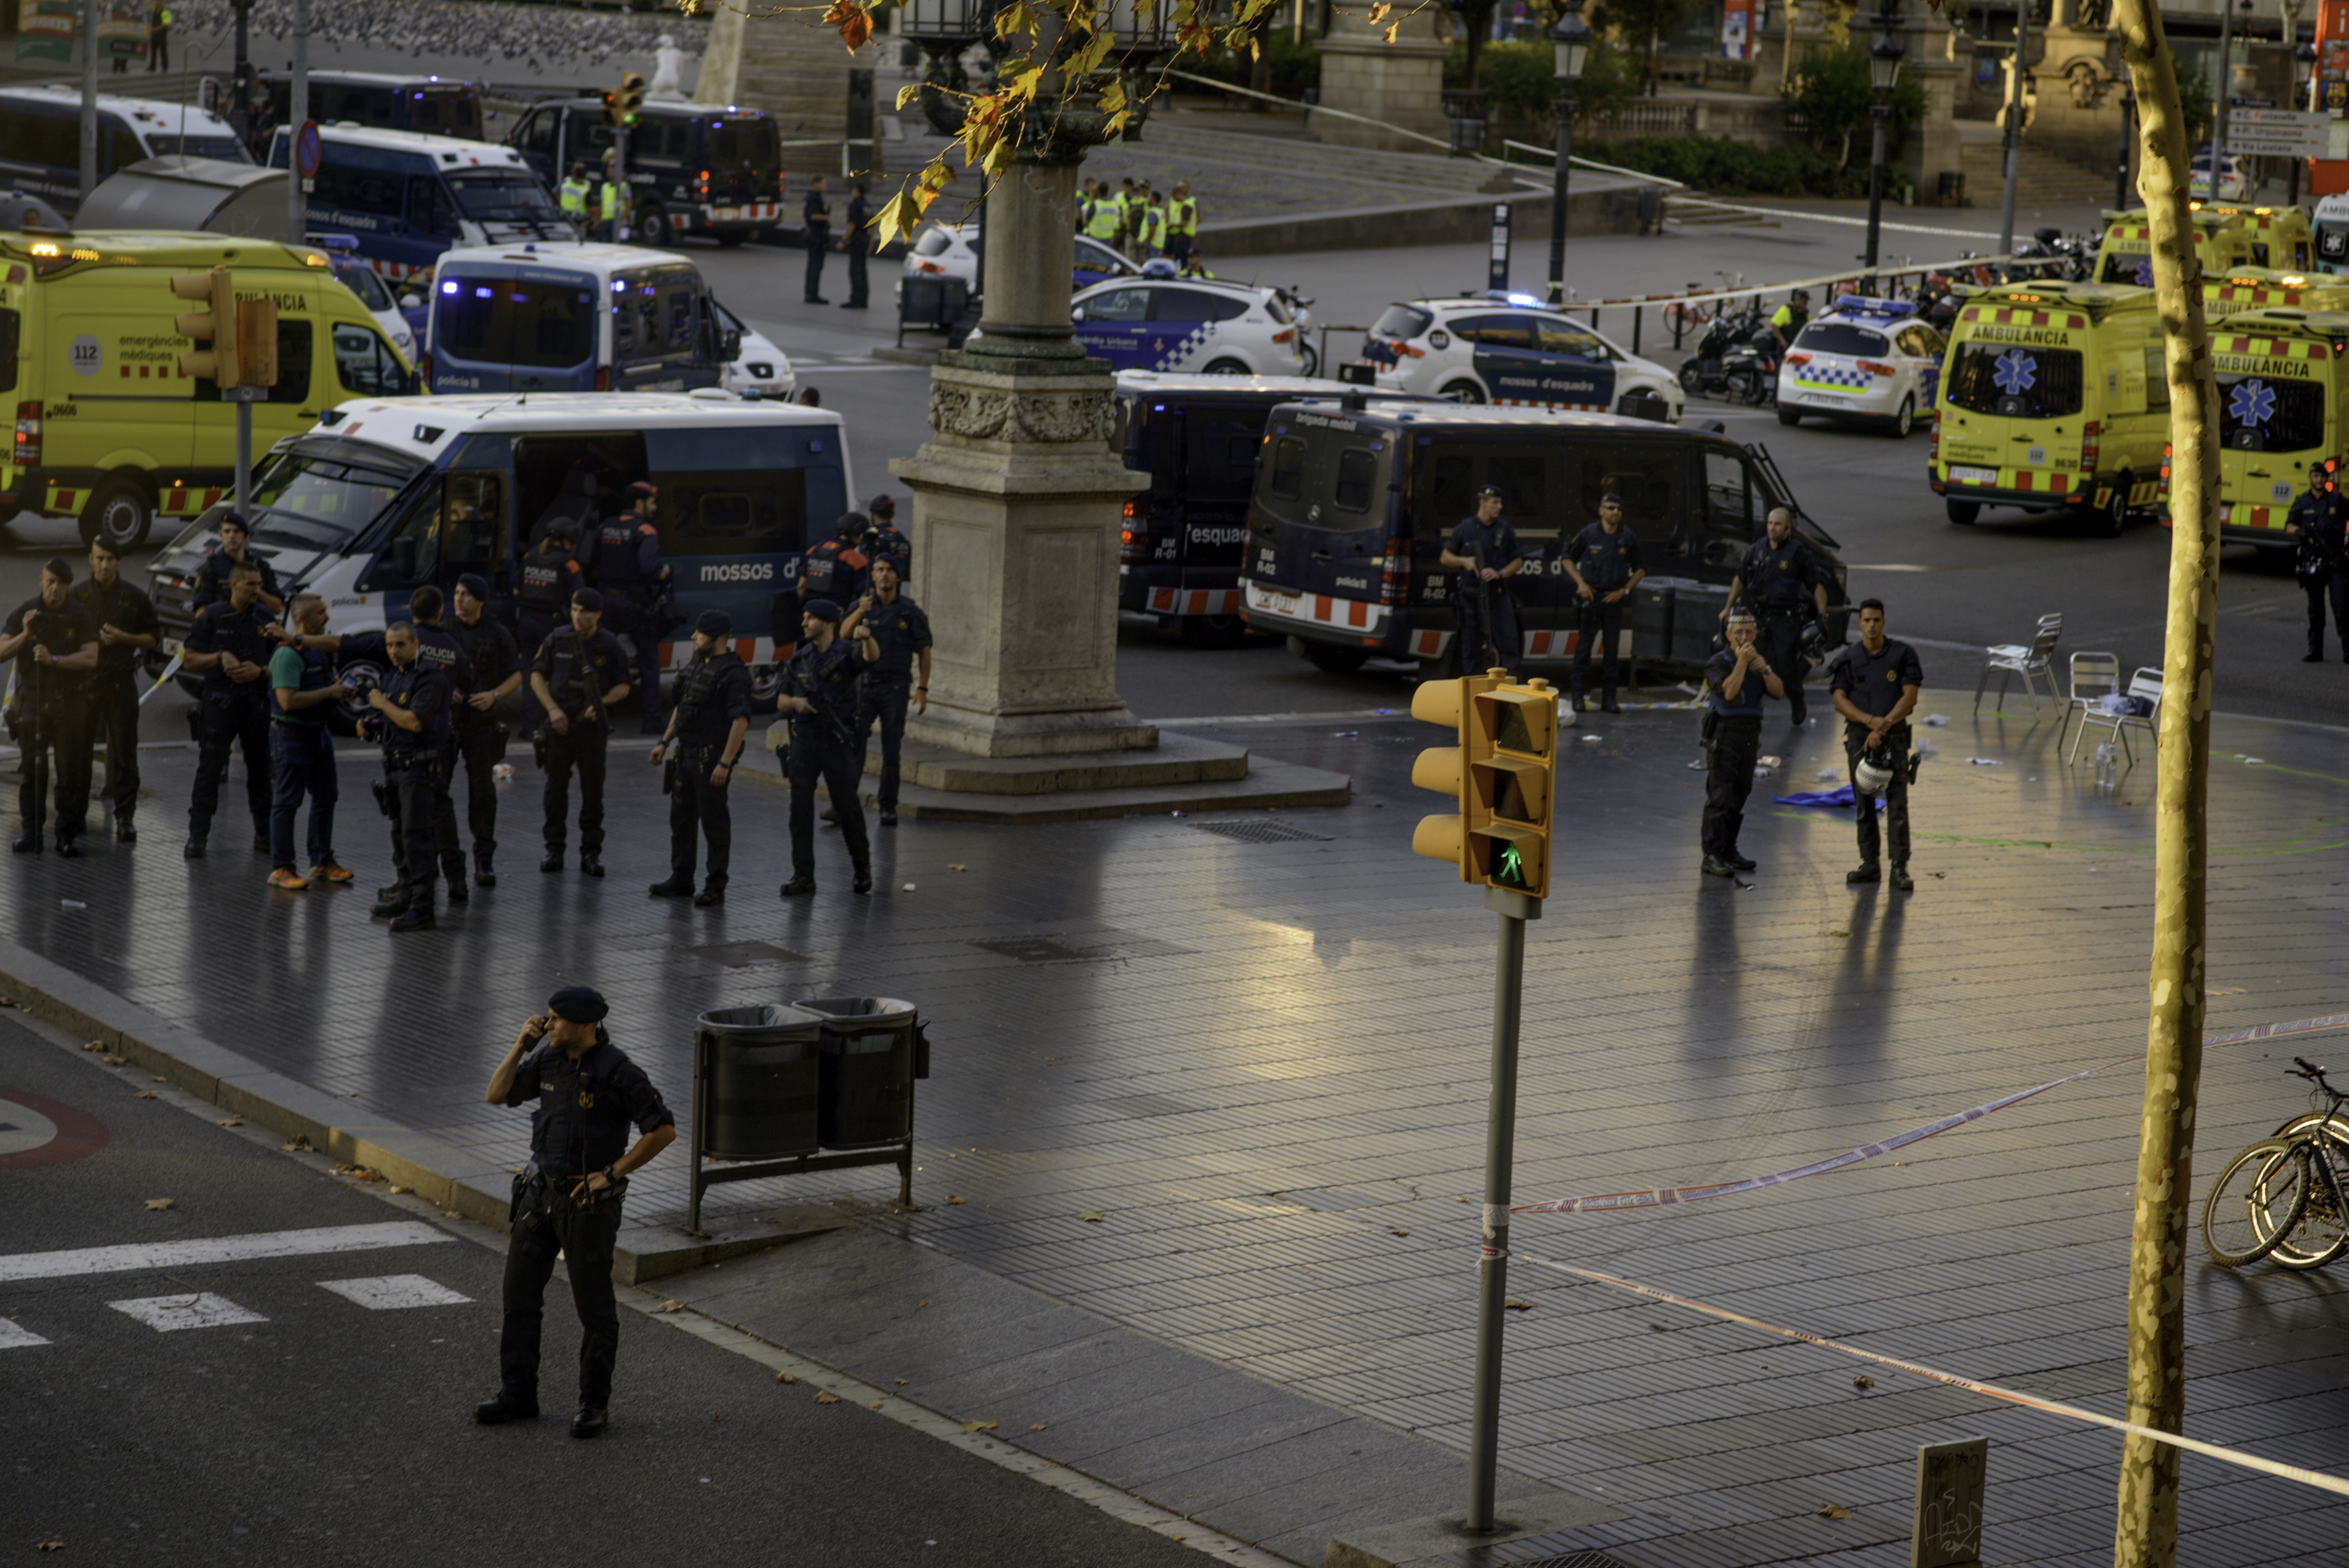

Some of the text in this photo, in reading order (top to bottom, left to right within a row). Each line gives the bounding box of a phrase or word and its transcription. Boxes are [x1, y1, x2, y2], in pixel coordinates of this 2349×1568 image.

[120, 336, 189, 349] emergències
[75, 345, 97, 359] 112
[120, 350, 173, 363] mèdiques
[1499, 376, 1595, 392] mossos d'esquadra
[1296, 412, 1328, 428] brigada
[2030, 450, 2044, 459] 112
[2275, 486, 2289, 496] 112
[1161, 537, 1176, 548] BM
[1155, 547, 1176, 560] R-01
[1260, 547, 1275, 562] BM
[524, 566, 557, 578] POLICIA
[700, 564, 774, 582] mossos
[1256, 560, 1276, 576] R-02
[1427, 575, 1444, 587] BM
[1423, 587, 1447, 600] R-02
[332, 596, 359, 608] policia
[420, 644, 457, 661] POLICIA
